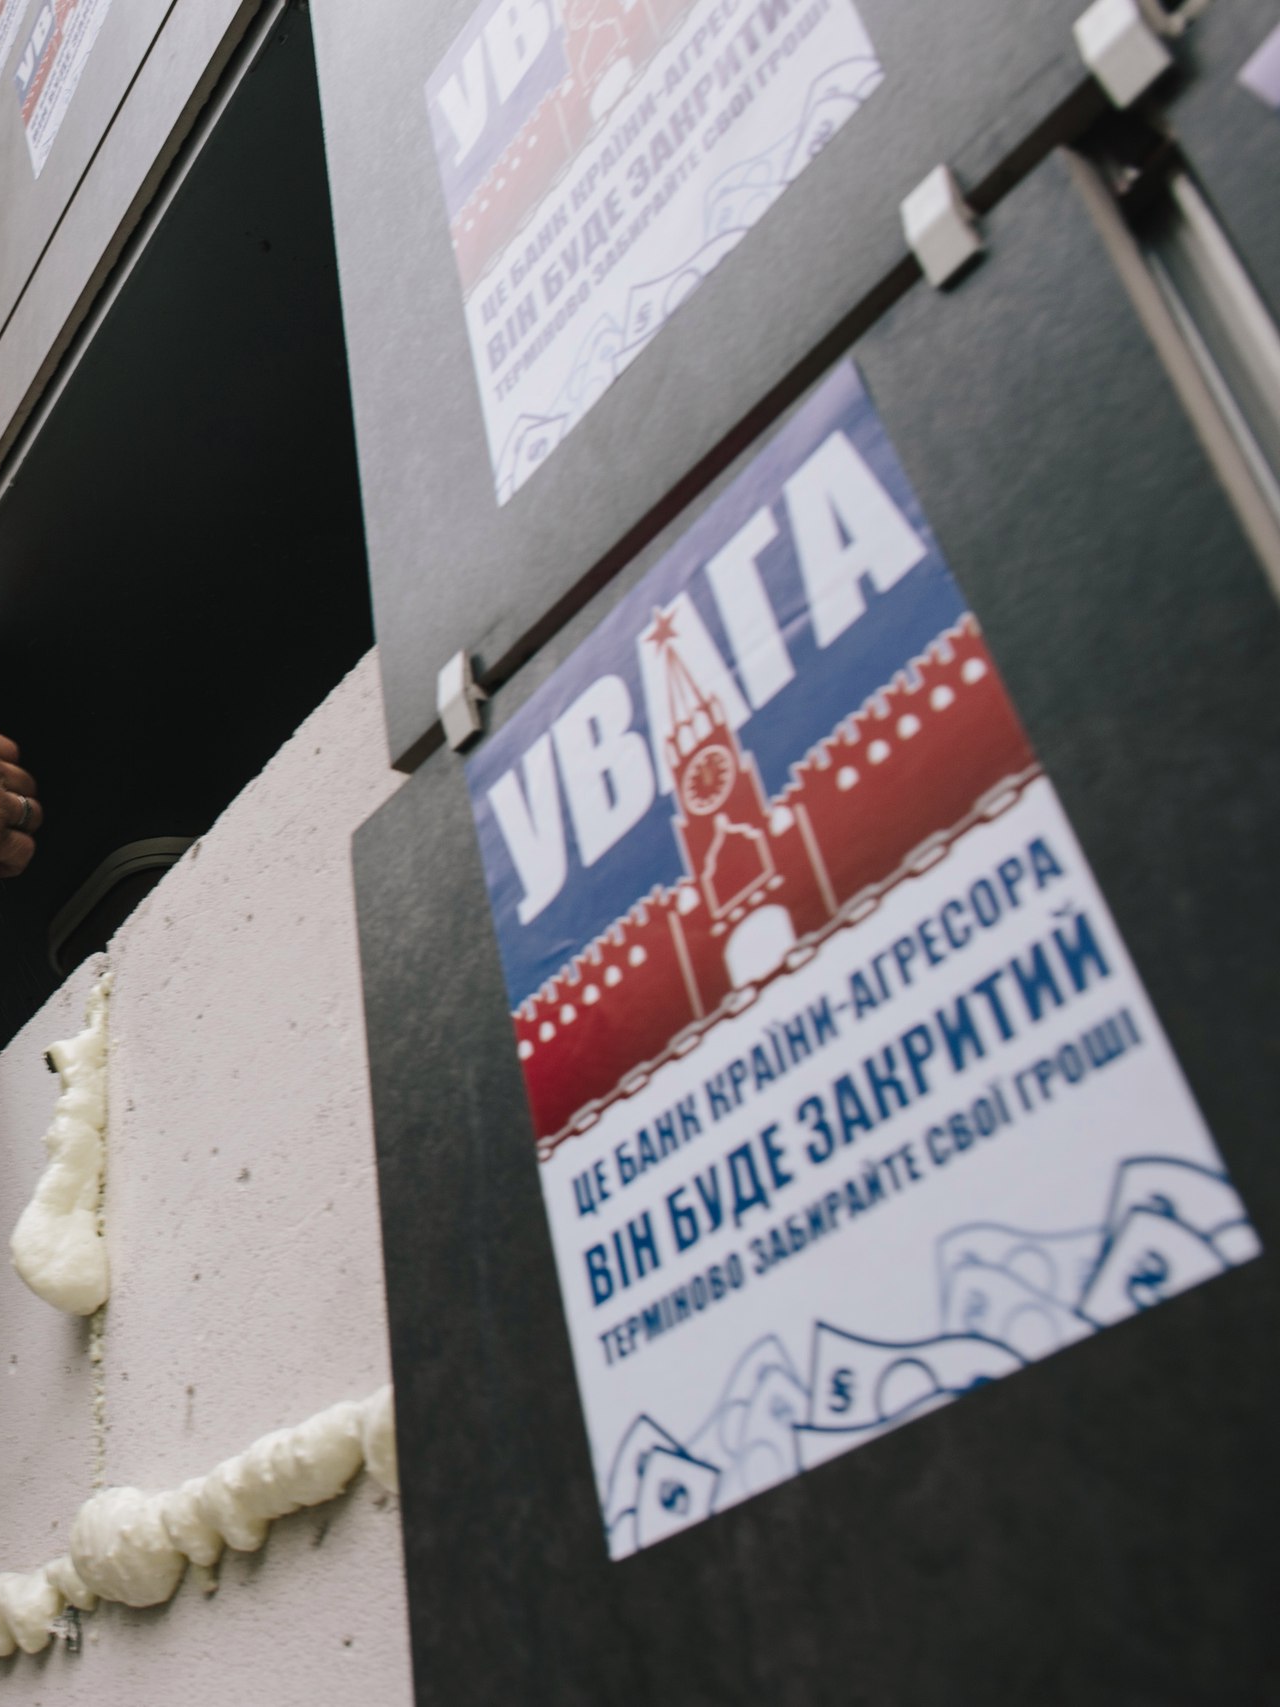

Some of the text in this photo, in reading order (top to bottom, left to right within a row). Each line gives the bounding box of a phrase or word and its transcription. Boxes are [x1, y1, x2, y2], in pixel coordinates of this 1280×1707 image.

[481, 279, 509, 326] ЦЕ
[510, 203, 569, 290] БАНК
[486, 0, 799, 374] ВІН БУДЕ ЗАКРИТИ
[487, 430, 927, 925] УВАГА
[571, 837, 1064, 1217] ЦЕ БАНК КРАЇНИ-АГРЕСОРА
[582, 901, 1115, 1307] ВІН БУДЕ ЗАКРИТИЙ
[599, 1006, 1142, 1366] ТЕРМІНОВО ЗАБИРАЙТЕ СВОЇ ГРОШІ
